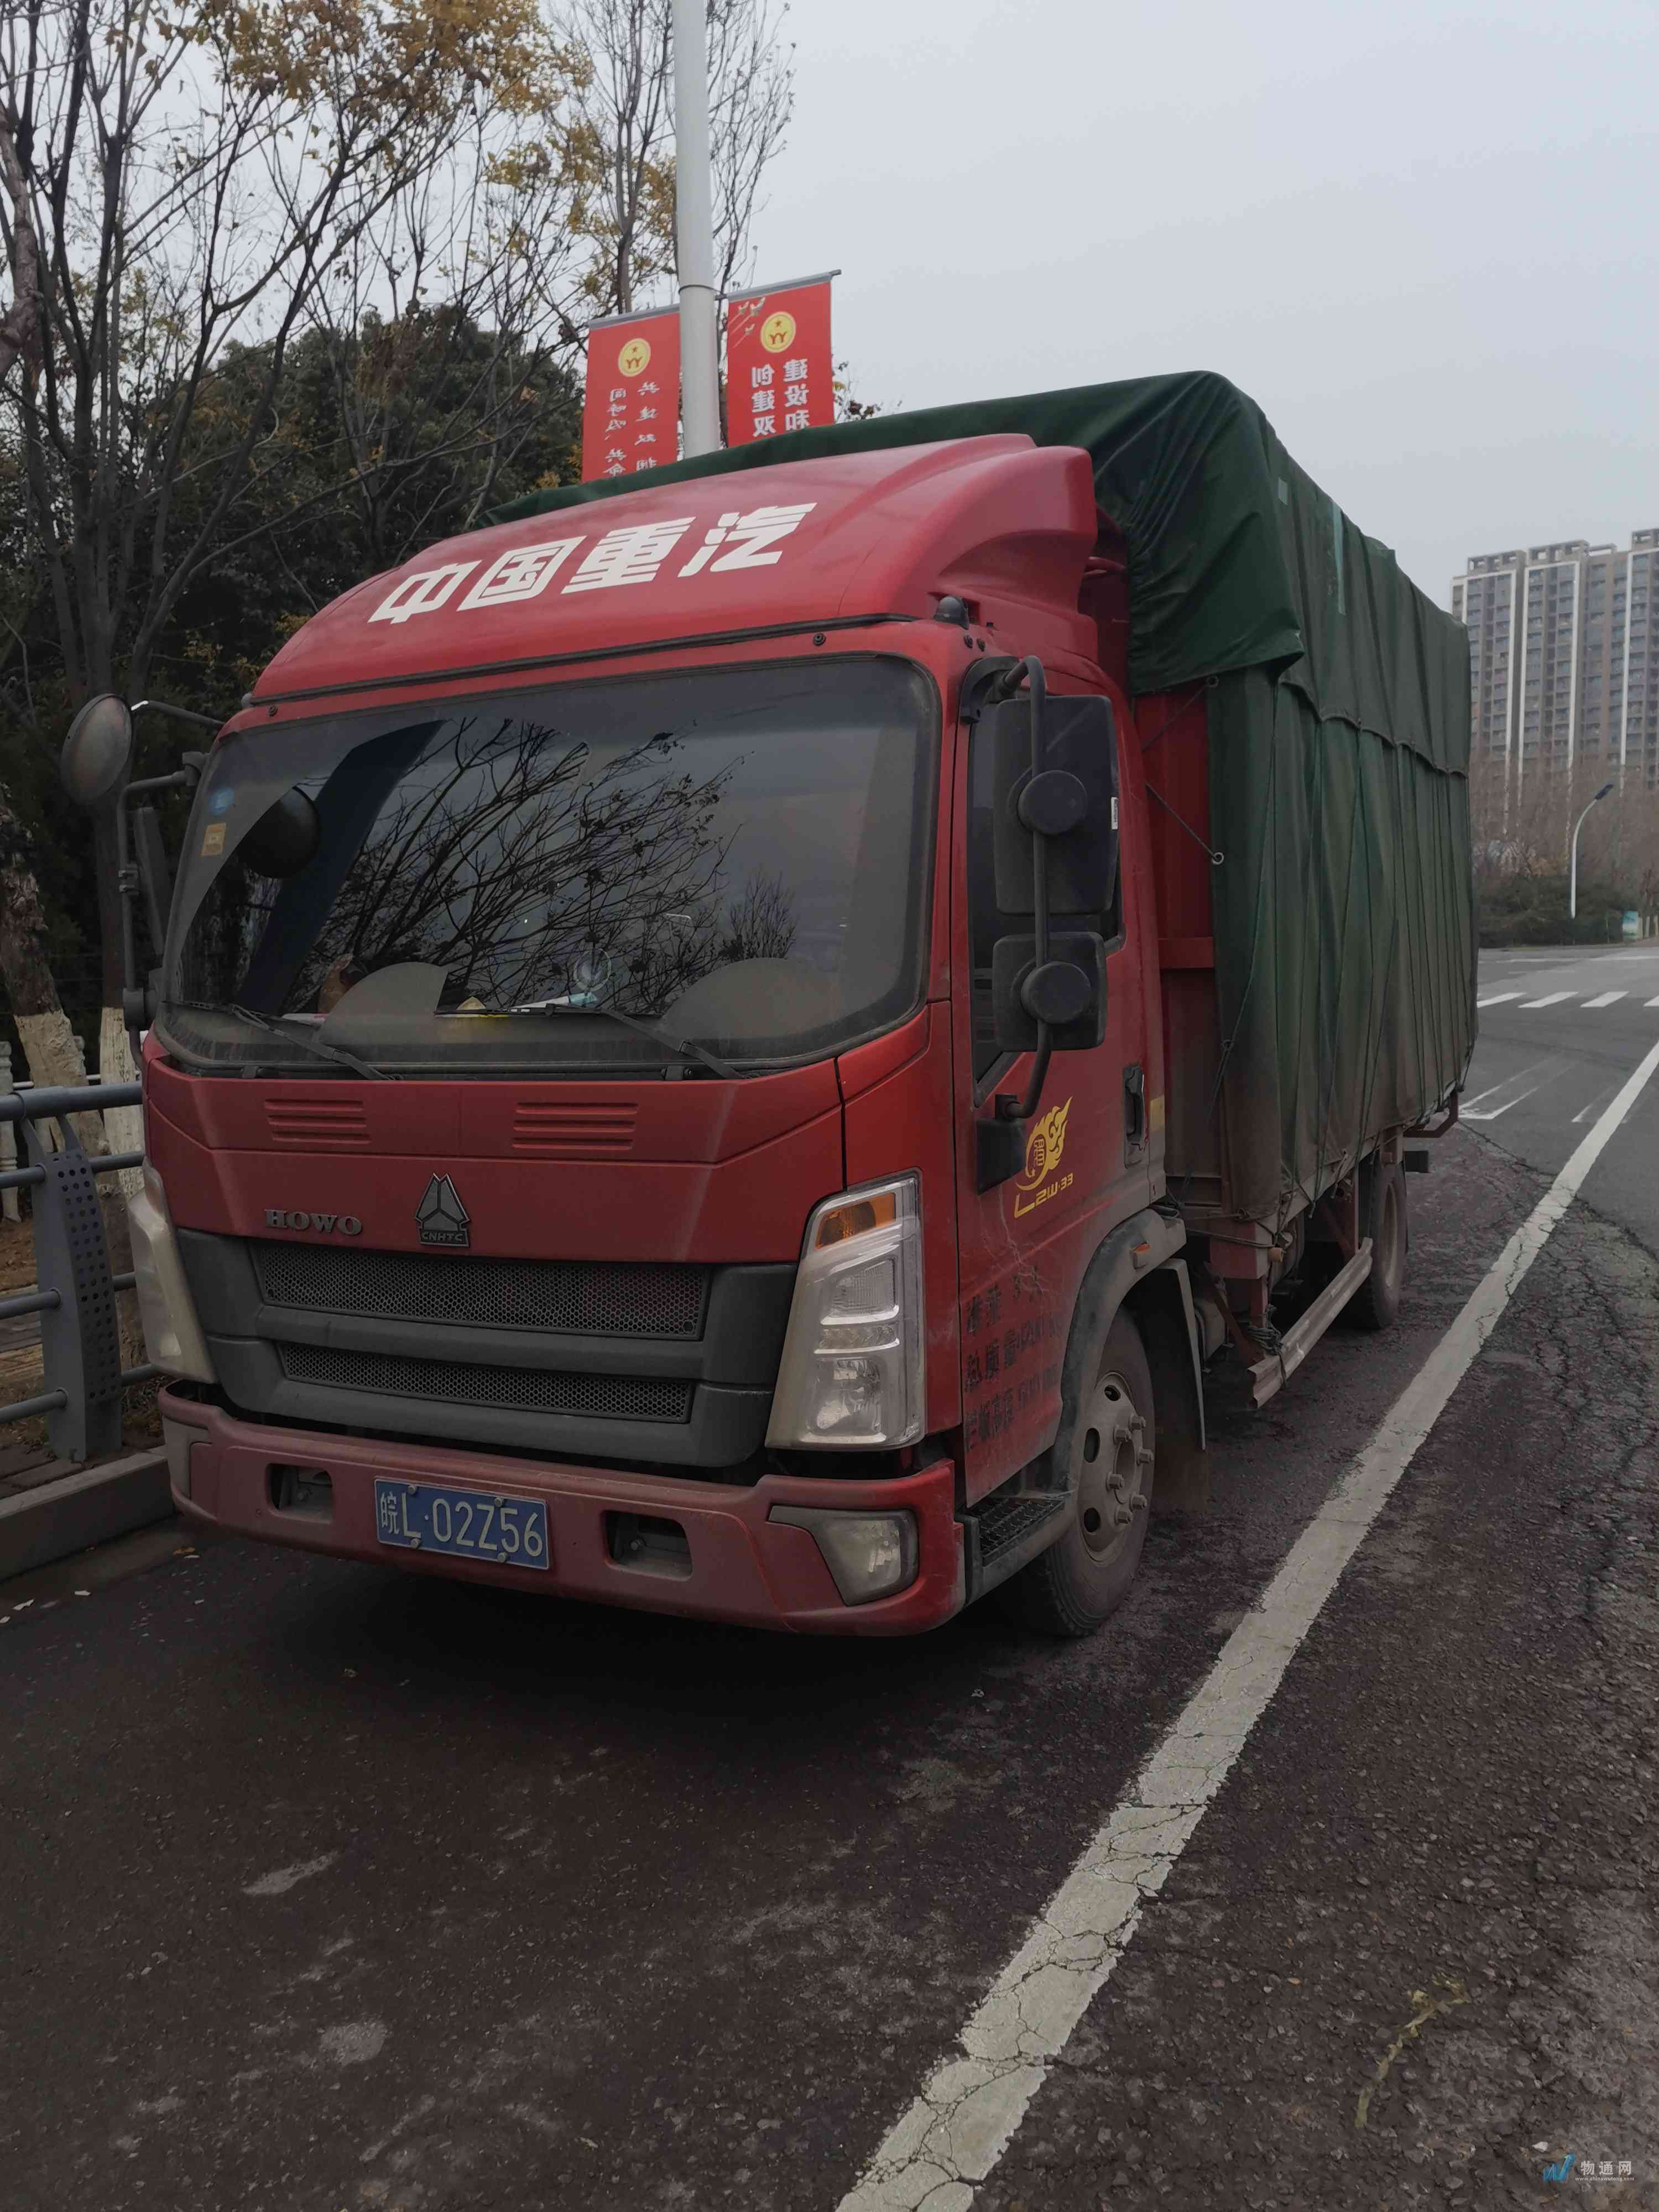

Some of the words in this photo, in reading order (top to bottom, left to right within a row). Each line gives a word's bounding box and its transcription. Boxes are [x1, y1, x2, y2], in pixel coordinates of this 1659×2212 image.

[367, 502, 817, 625] 中国重汽
[264, 1208, 363, 1236] HOWO
[421, 1232, 465, 1243] CNHTC
